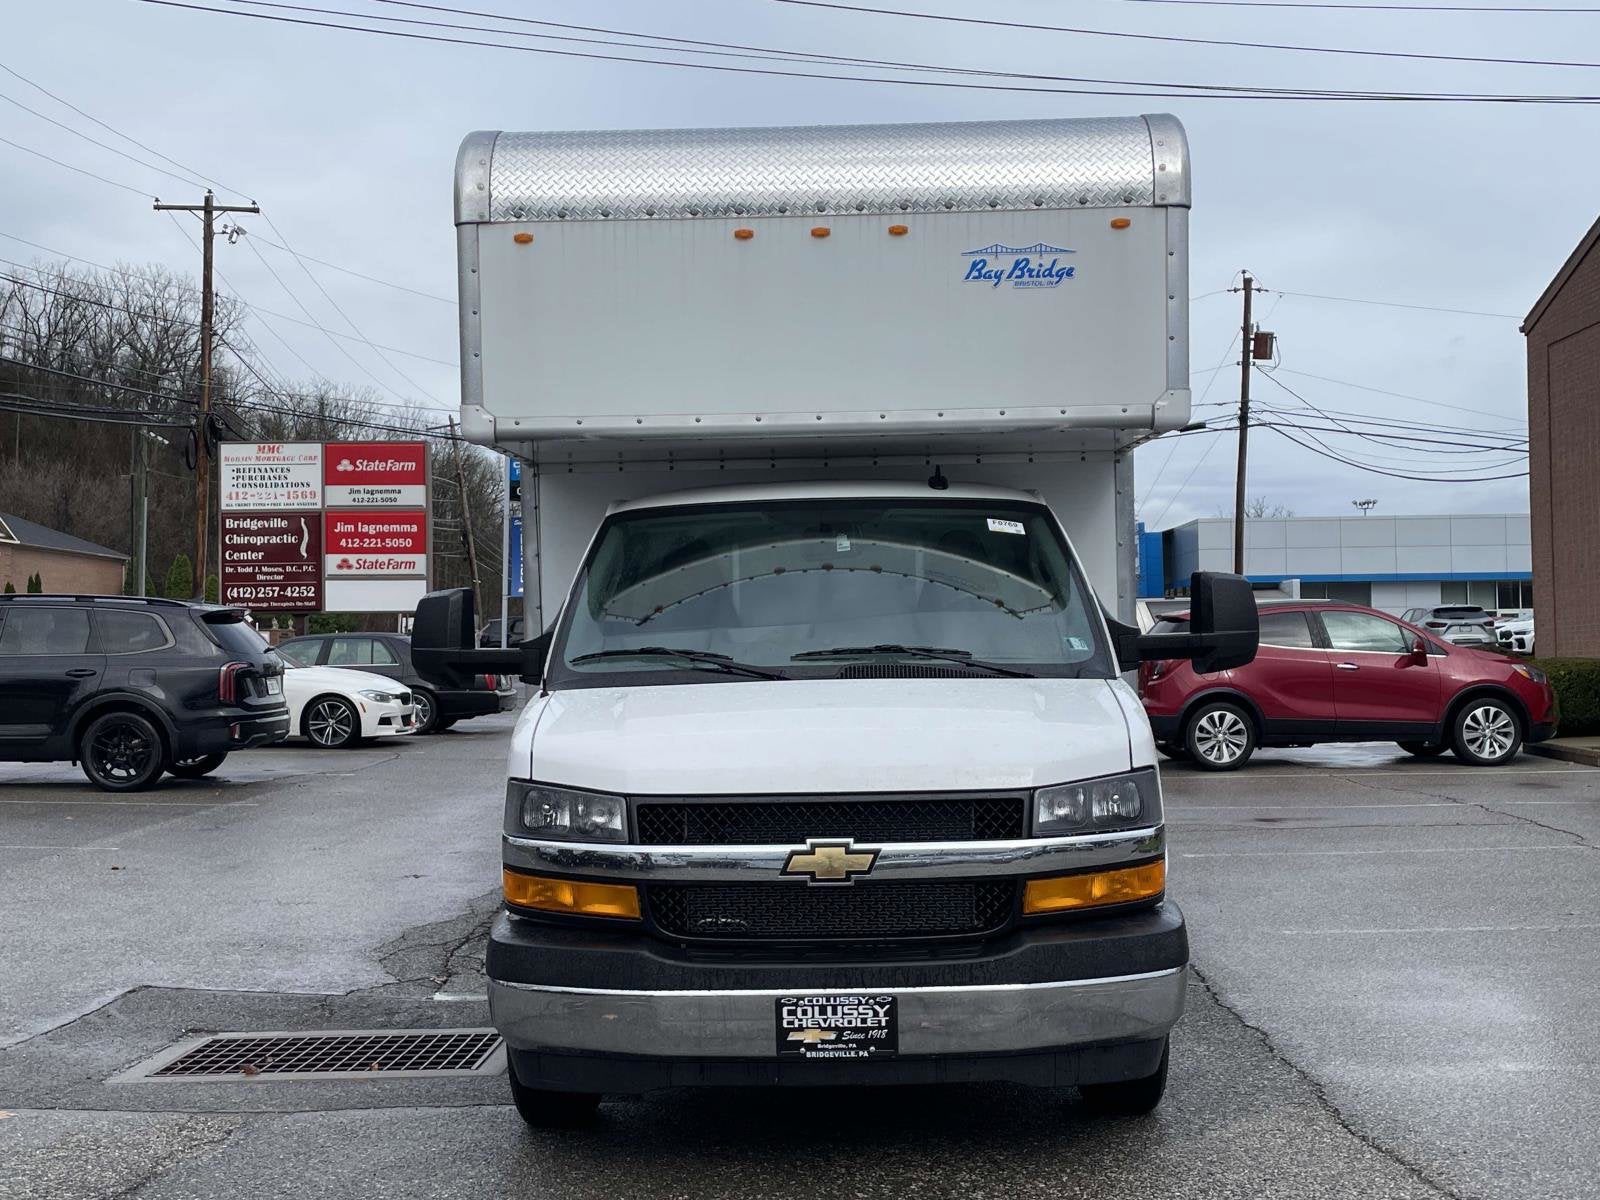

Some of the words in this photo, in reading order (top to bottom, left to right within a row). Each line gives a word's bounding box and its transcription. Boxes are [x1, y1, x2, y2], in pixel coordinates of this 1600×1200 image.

[964, 258, 1005, 287] Bay
[1006, 257, 1076, 285] Bridge
[256, 445, 284, 454] MMC
[226, 491, 317, 500] 412-221-1569
[225, 518, 288, 530] Bridgeville
[334, 522, 354, 532] Jim
[225, 533, 298, 546] Chiropractic
[340, 538, 412, 547] 412-221-5050
[225, 550, 264, 560] Center
[227, 587, 256, 600] (412)
[257, 586, 316, 598] 257-4252
[804, 996, 869, 1005] COLUSSY
[782, 1005, 890, 1019] COLUSSY
[782, 1017, 889, 1028] CHEVROLET
[841, 1031, 865, 1040] Since
[867, 1029, 889, 1039] 1918
